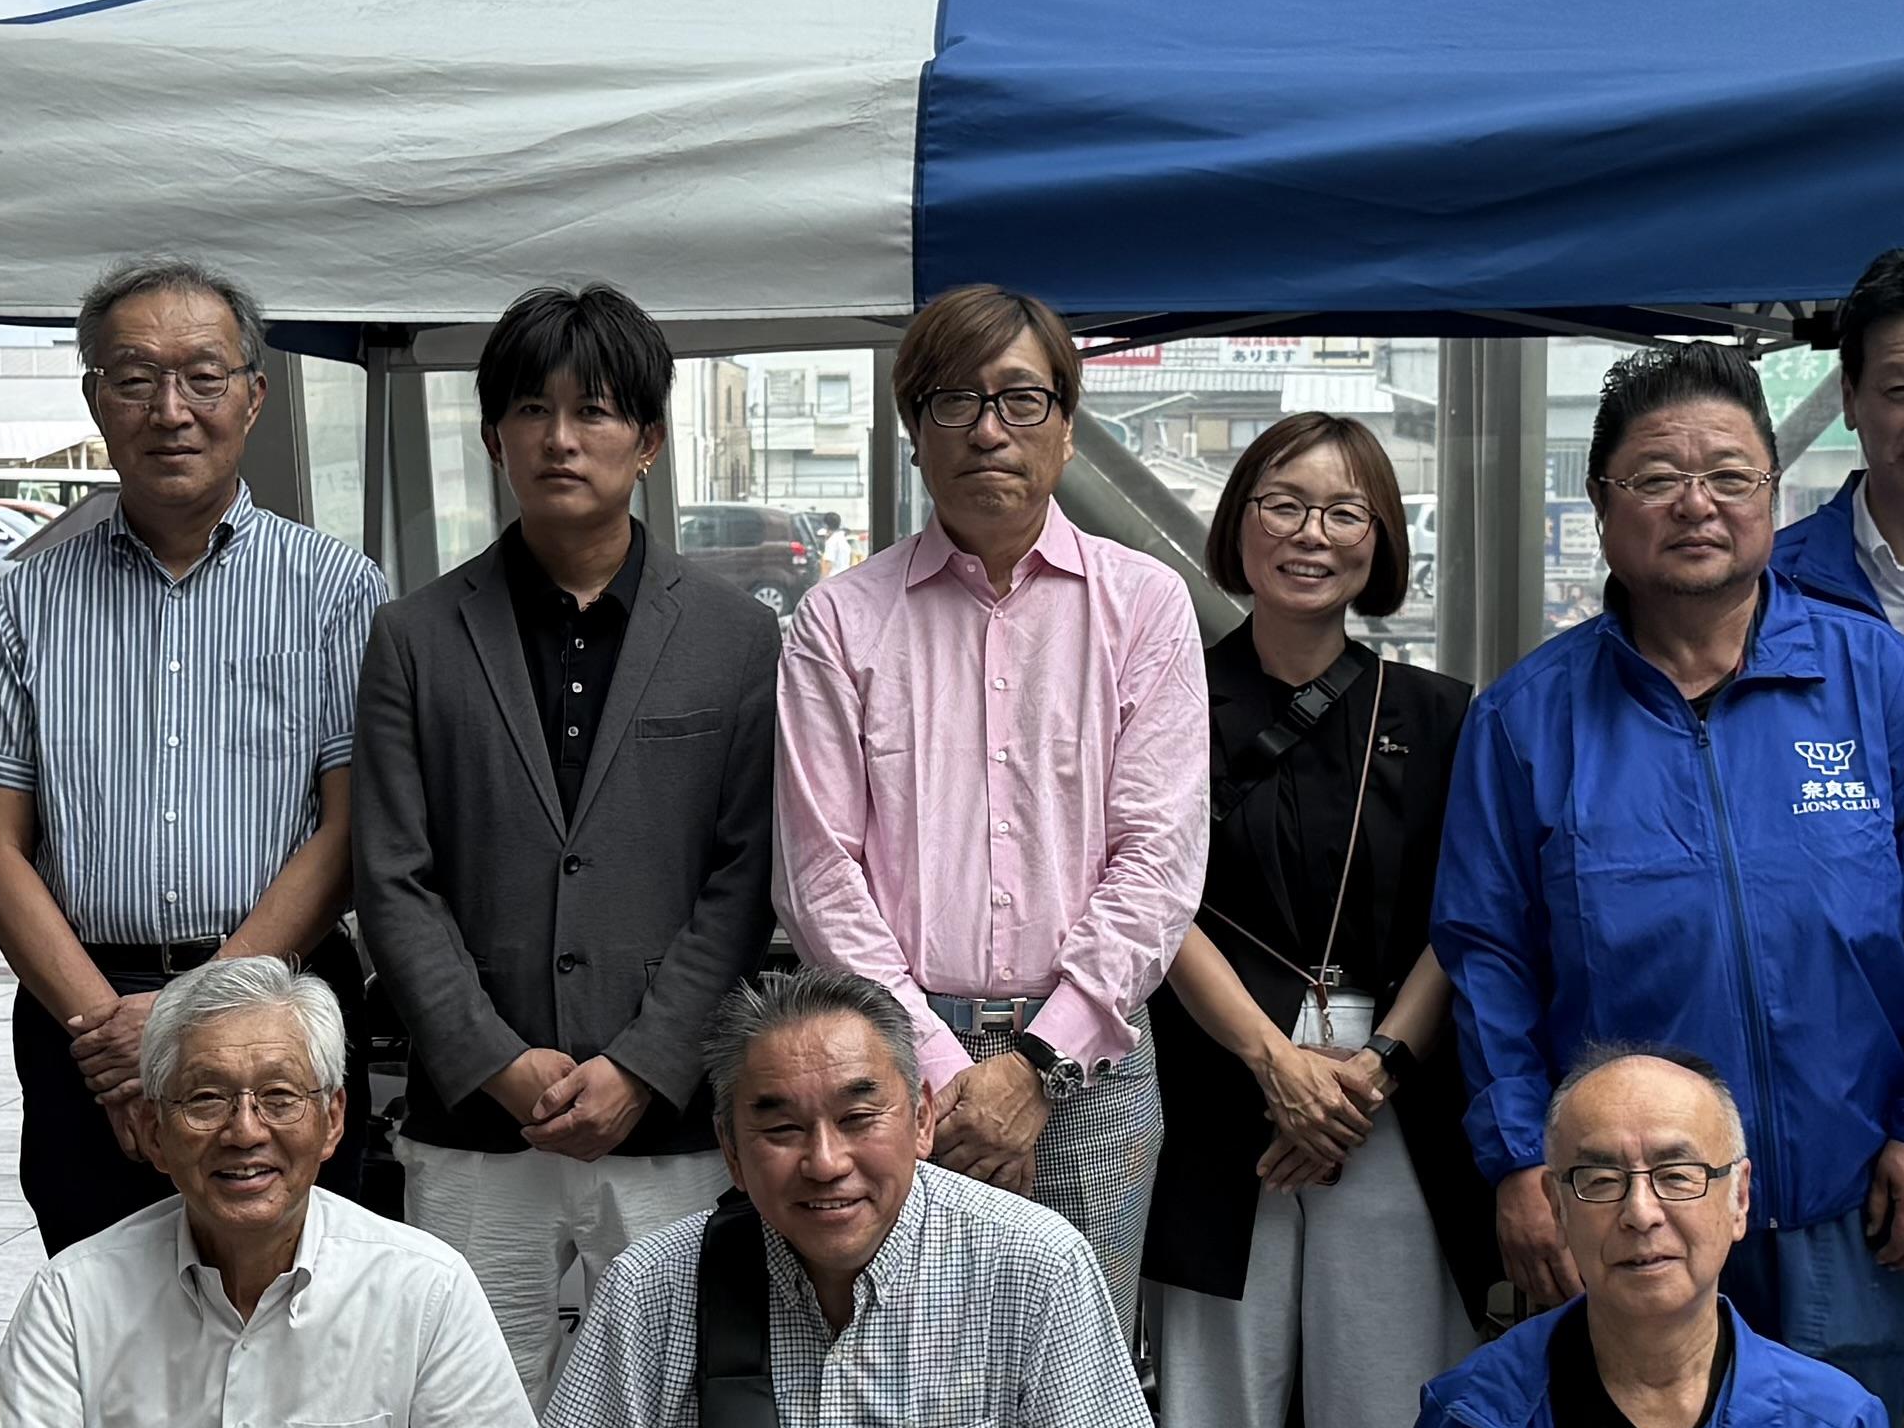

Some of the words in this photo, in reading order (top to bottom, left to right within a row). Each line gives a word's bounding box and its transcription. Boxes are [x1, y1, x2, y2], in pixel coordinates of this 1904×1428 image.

[1801, 779, 1866, 800] 奈良西
[1792, 800, 1841, 815] LIONS
[1841, 797, 1881, 811] CLUB
